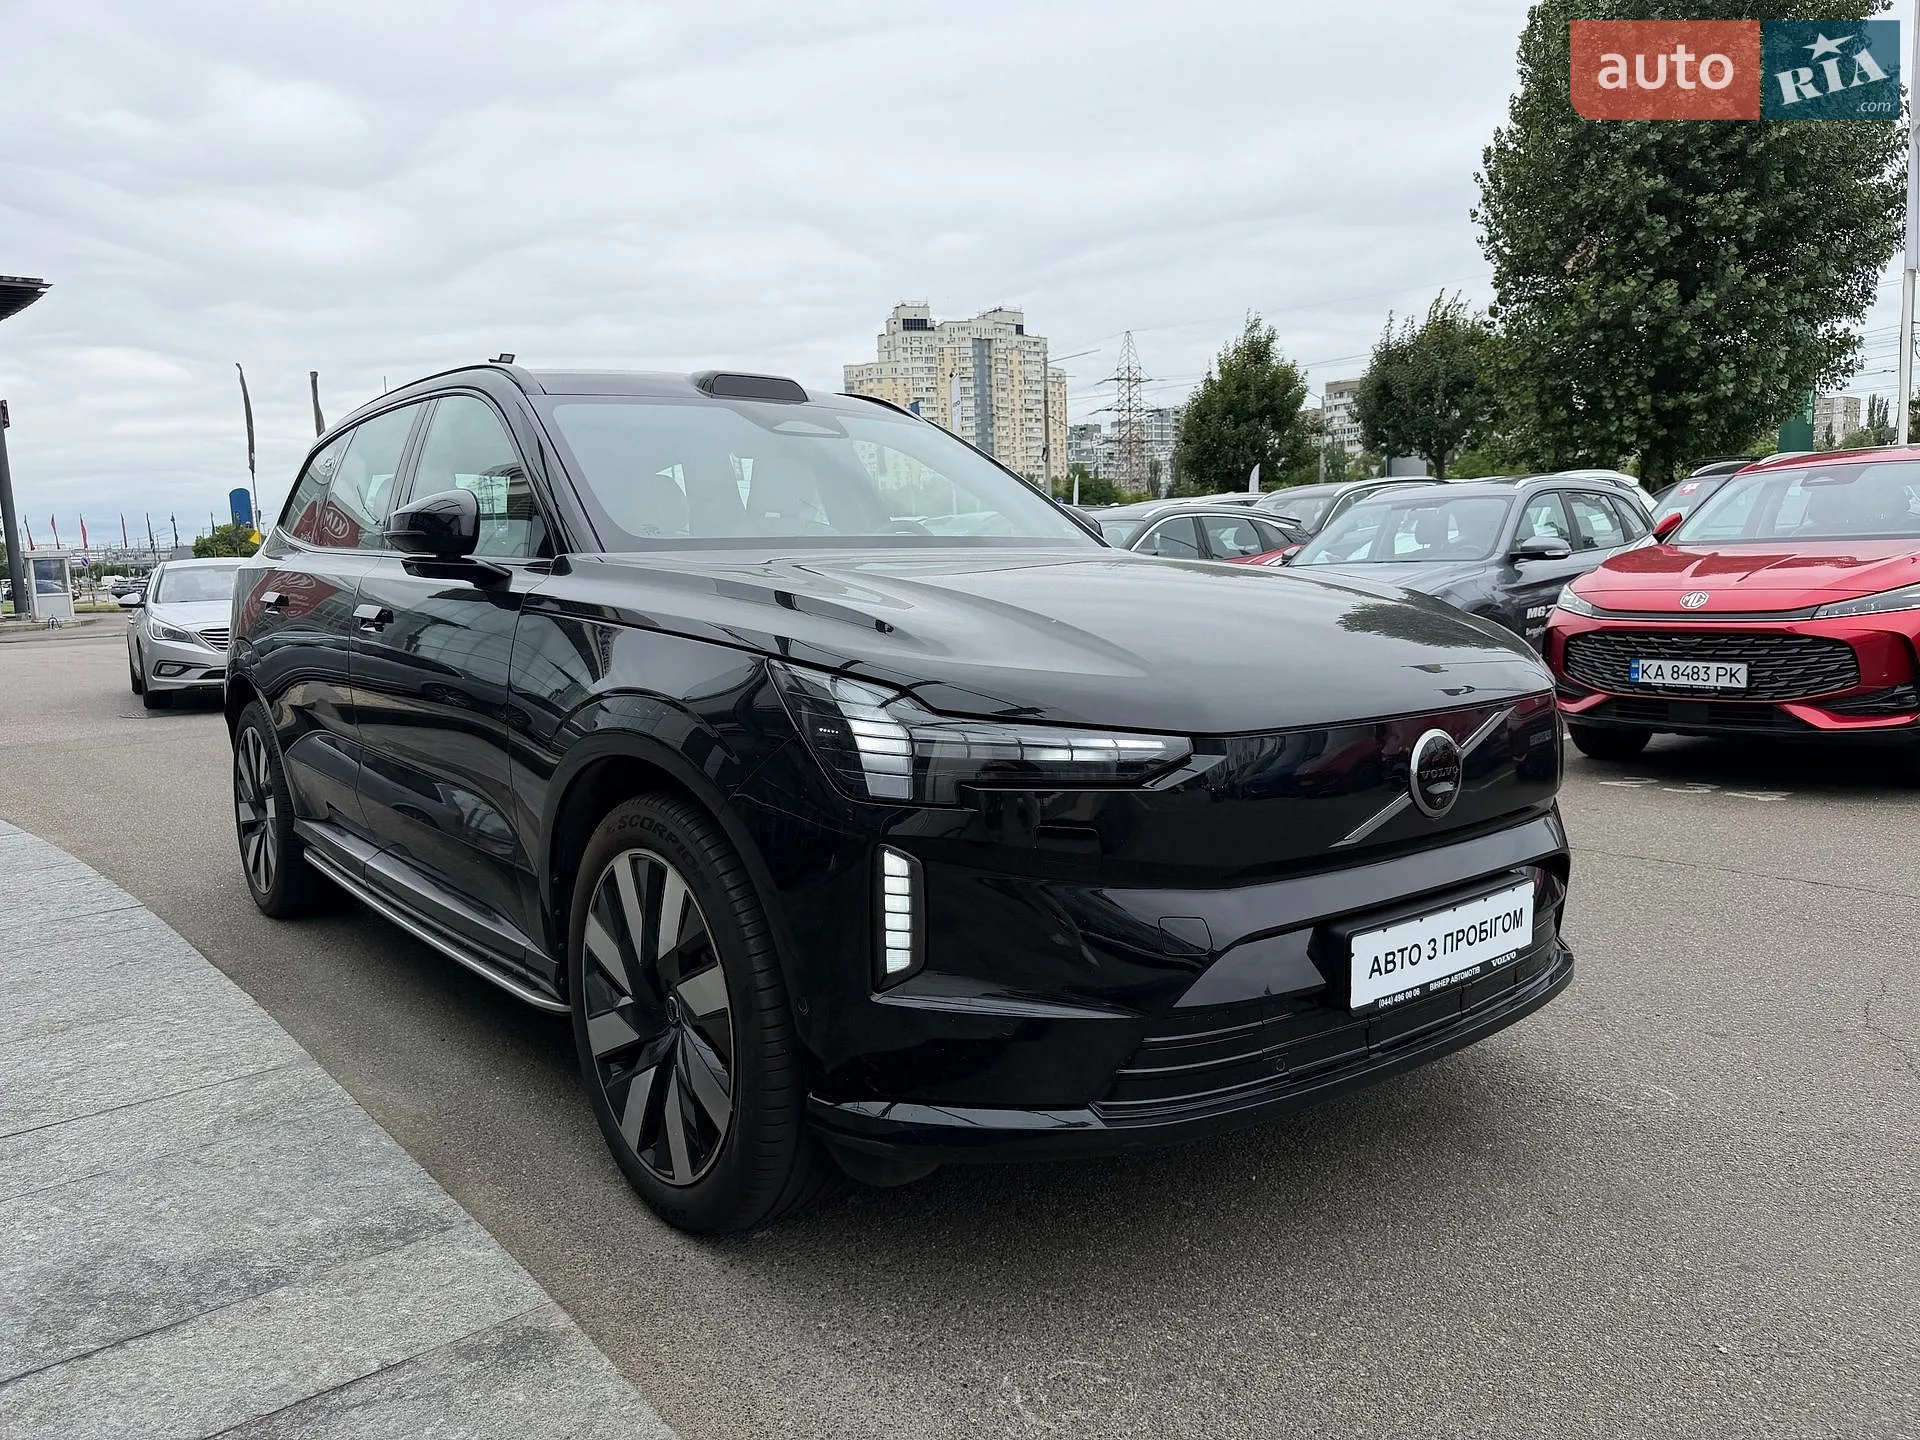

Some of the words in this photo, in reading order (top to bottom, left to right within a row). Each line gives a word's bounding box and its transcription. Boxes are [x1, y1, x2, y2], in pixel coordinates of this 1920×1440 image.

[1681, 592, 1707, 608] MG
[1641, 663, 1665, 680] KA
[1671, 664, 1711, 682] 8483
[1716, 666, 1742, 684] PK
[1420, 766, 1460, 780] VOLVO
[618, 814, 709, 884] SCORPIO
[1368, 943, 1422, 979] АВТО
[1443, 907, 1523, 955] ПРОБІГОМ
[1491, 951, 1517, 967] VOLVO
[1450, 966, 1480, 983] АВТОМОТІВ
[1378, 995, 1393, 1009] (044)
[1394, 992, 1405, 1003] 496
